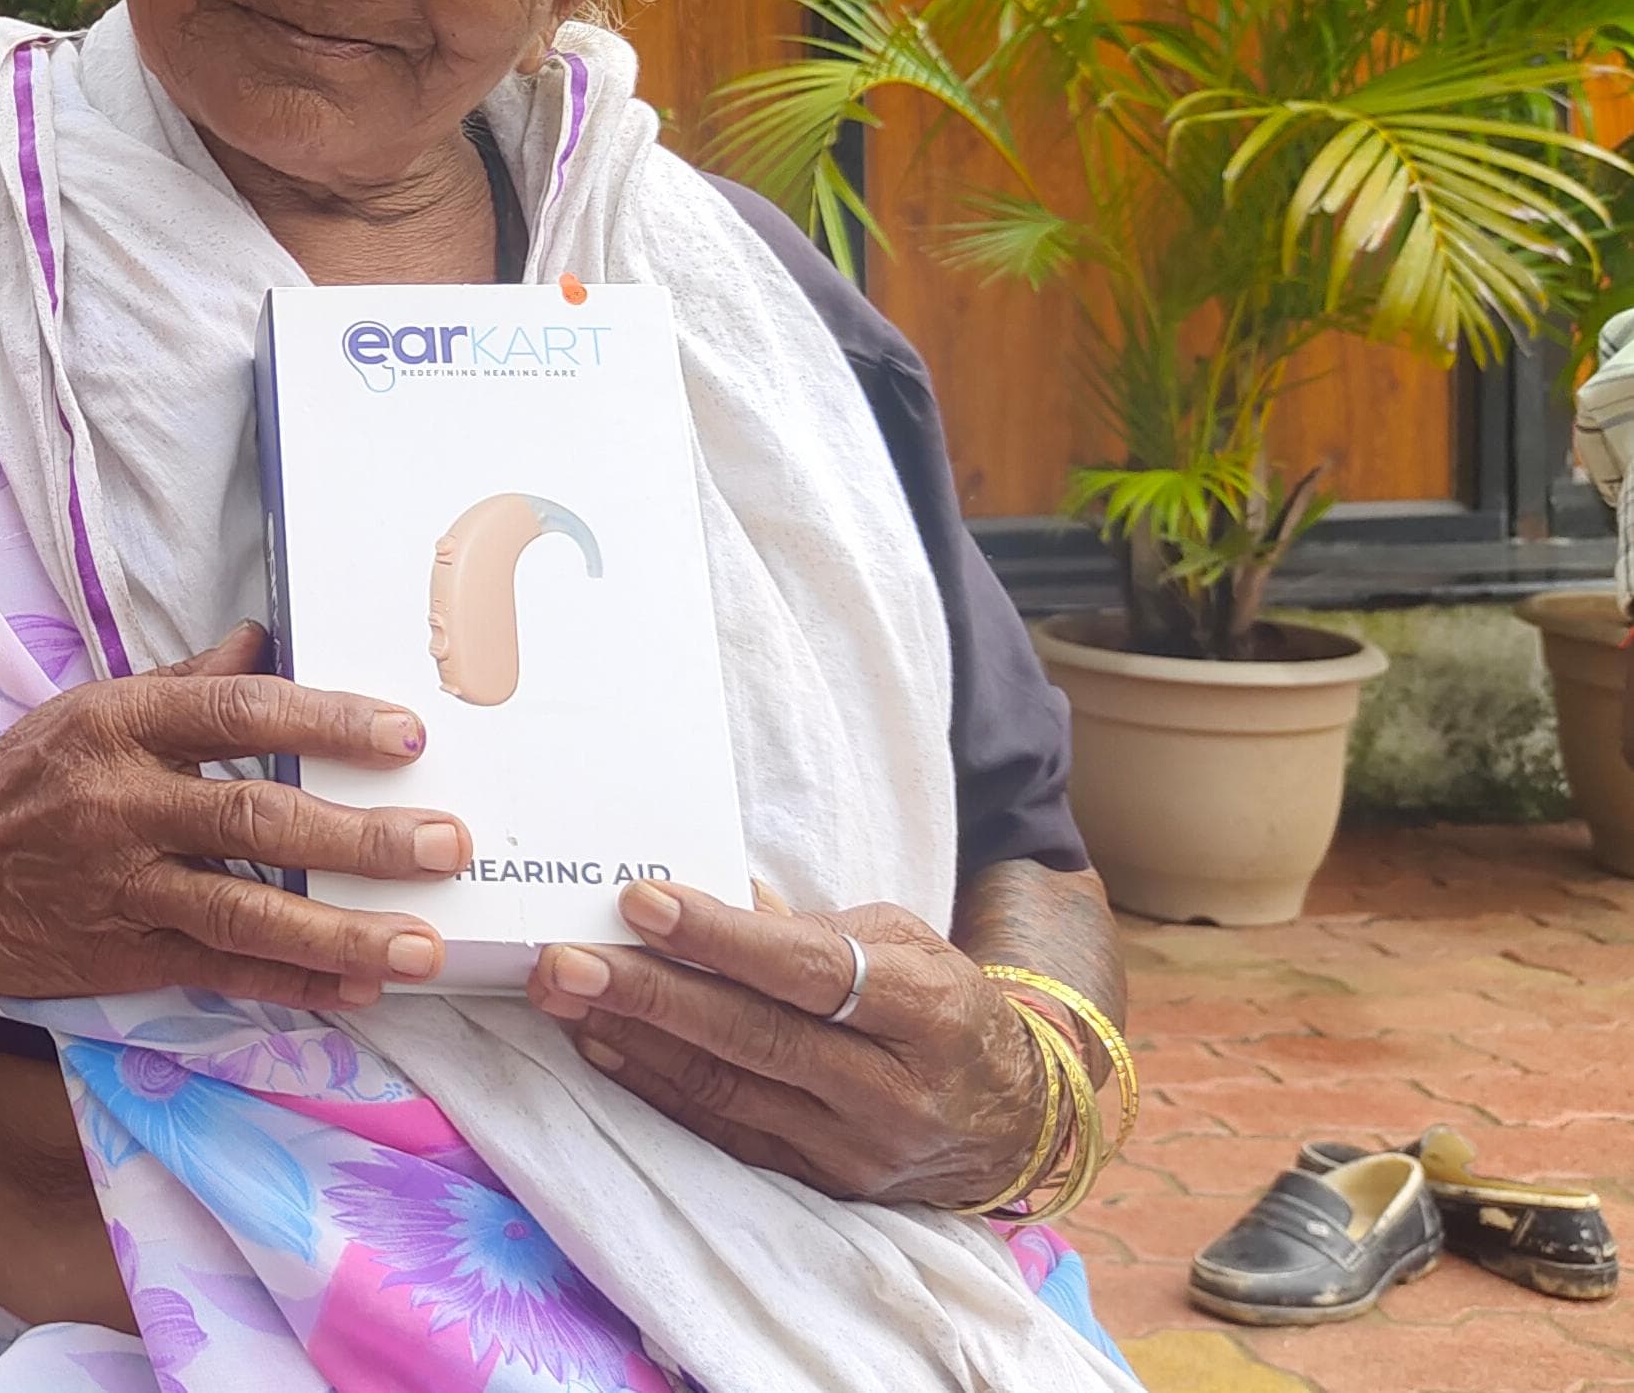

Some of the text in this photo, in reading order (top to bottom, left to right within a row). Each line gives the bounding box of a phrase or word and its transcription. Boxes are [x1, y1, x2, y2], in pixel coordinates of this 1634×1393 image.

[343, 322, 611, 367] earKART
[401, 369, 577, 377] REDEFINING HEARING CARE
